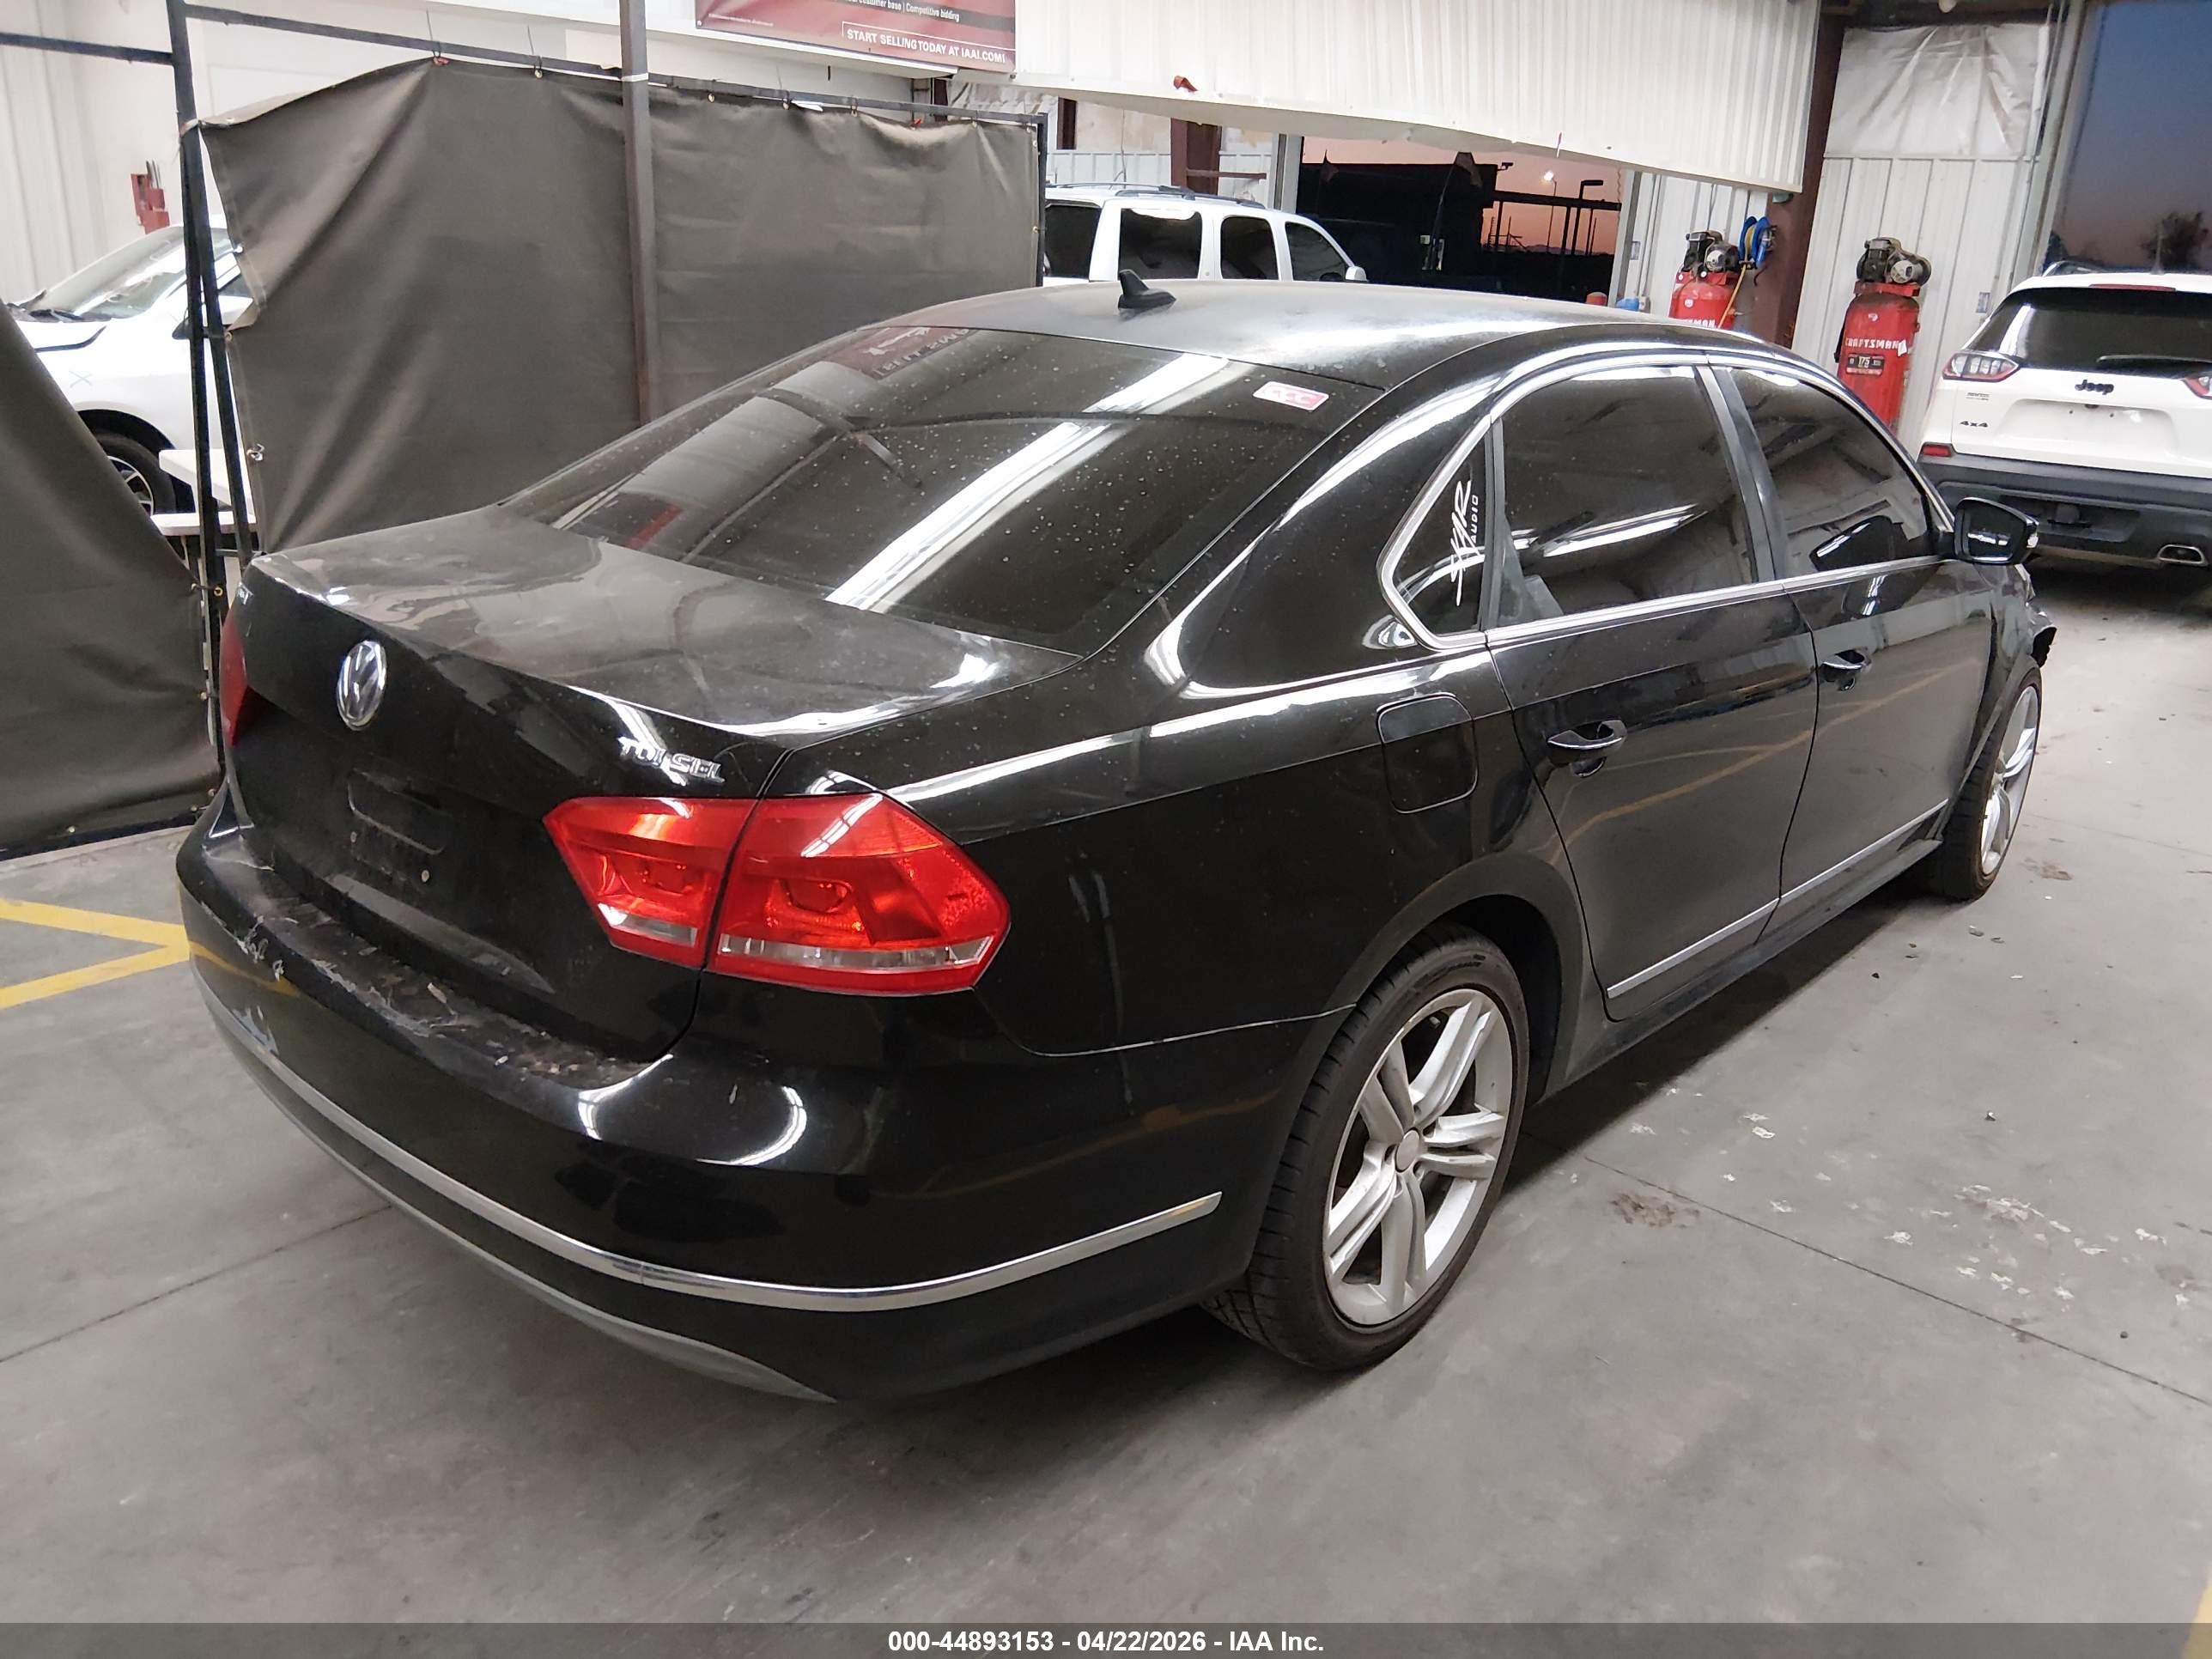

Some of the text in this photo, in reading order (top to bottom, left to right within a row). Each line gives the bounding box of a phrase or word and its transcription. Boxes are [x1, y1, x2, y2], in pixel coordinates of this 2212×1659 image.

[888, 0, 902, 10] base
[906, 3, 940, 17] Competitive
[940, 9, 960, 22] bidding
[847, 28, 878, 44] START
[880, 34, 917, 50] SELLING
[918, 40, 946, 54] TODAY
[948, 46, 960, 57] AT
[1844, 337, 1899, 349] CRAFTSMAN
[2075, 379, 2115, 396] Jeep
[1470, 495, 1479, 544] AUDIO
